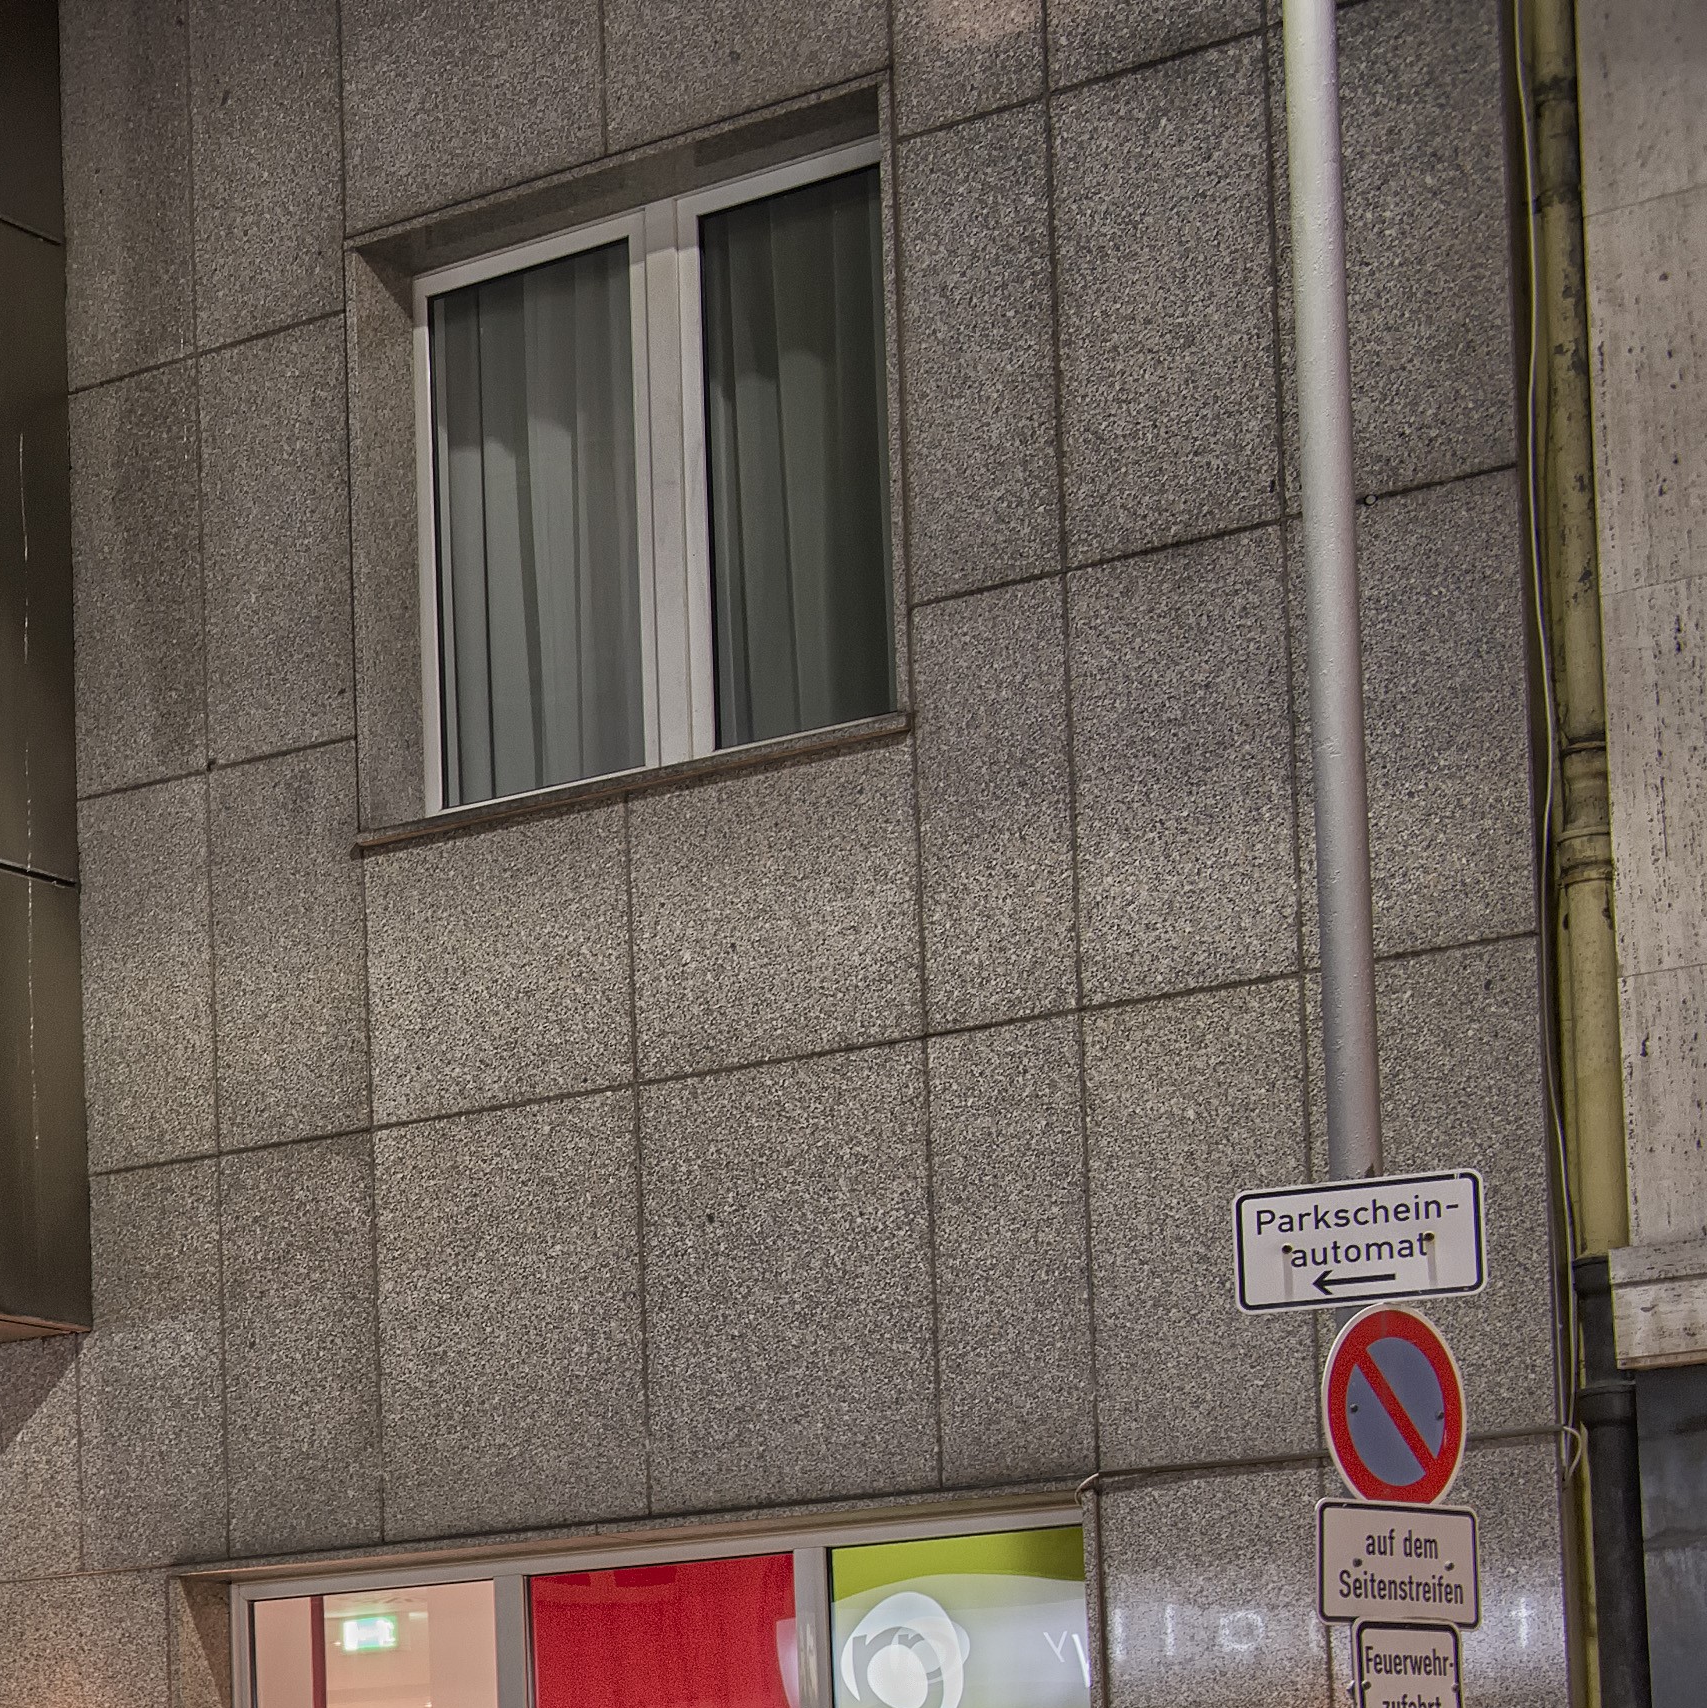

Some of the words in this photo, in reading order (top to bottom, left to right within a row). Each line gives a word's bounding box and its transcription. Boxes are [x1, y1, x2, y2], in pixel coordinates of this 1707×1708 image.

[1256, 1193, 1459, 1236] Parkschein-
[1290, 1233, 1429, 1269] automat
[1365, 1529, 1396, 1557] auf
[1403, 1530, 1439, 1560] dem
[1339, 1570, 1464, 1605] Seitenstreifen
[1365, 1645, 1455, 1677] Feuerwehr-
